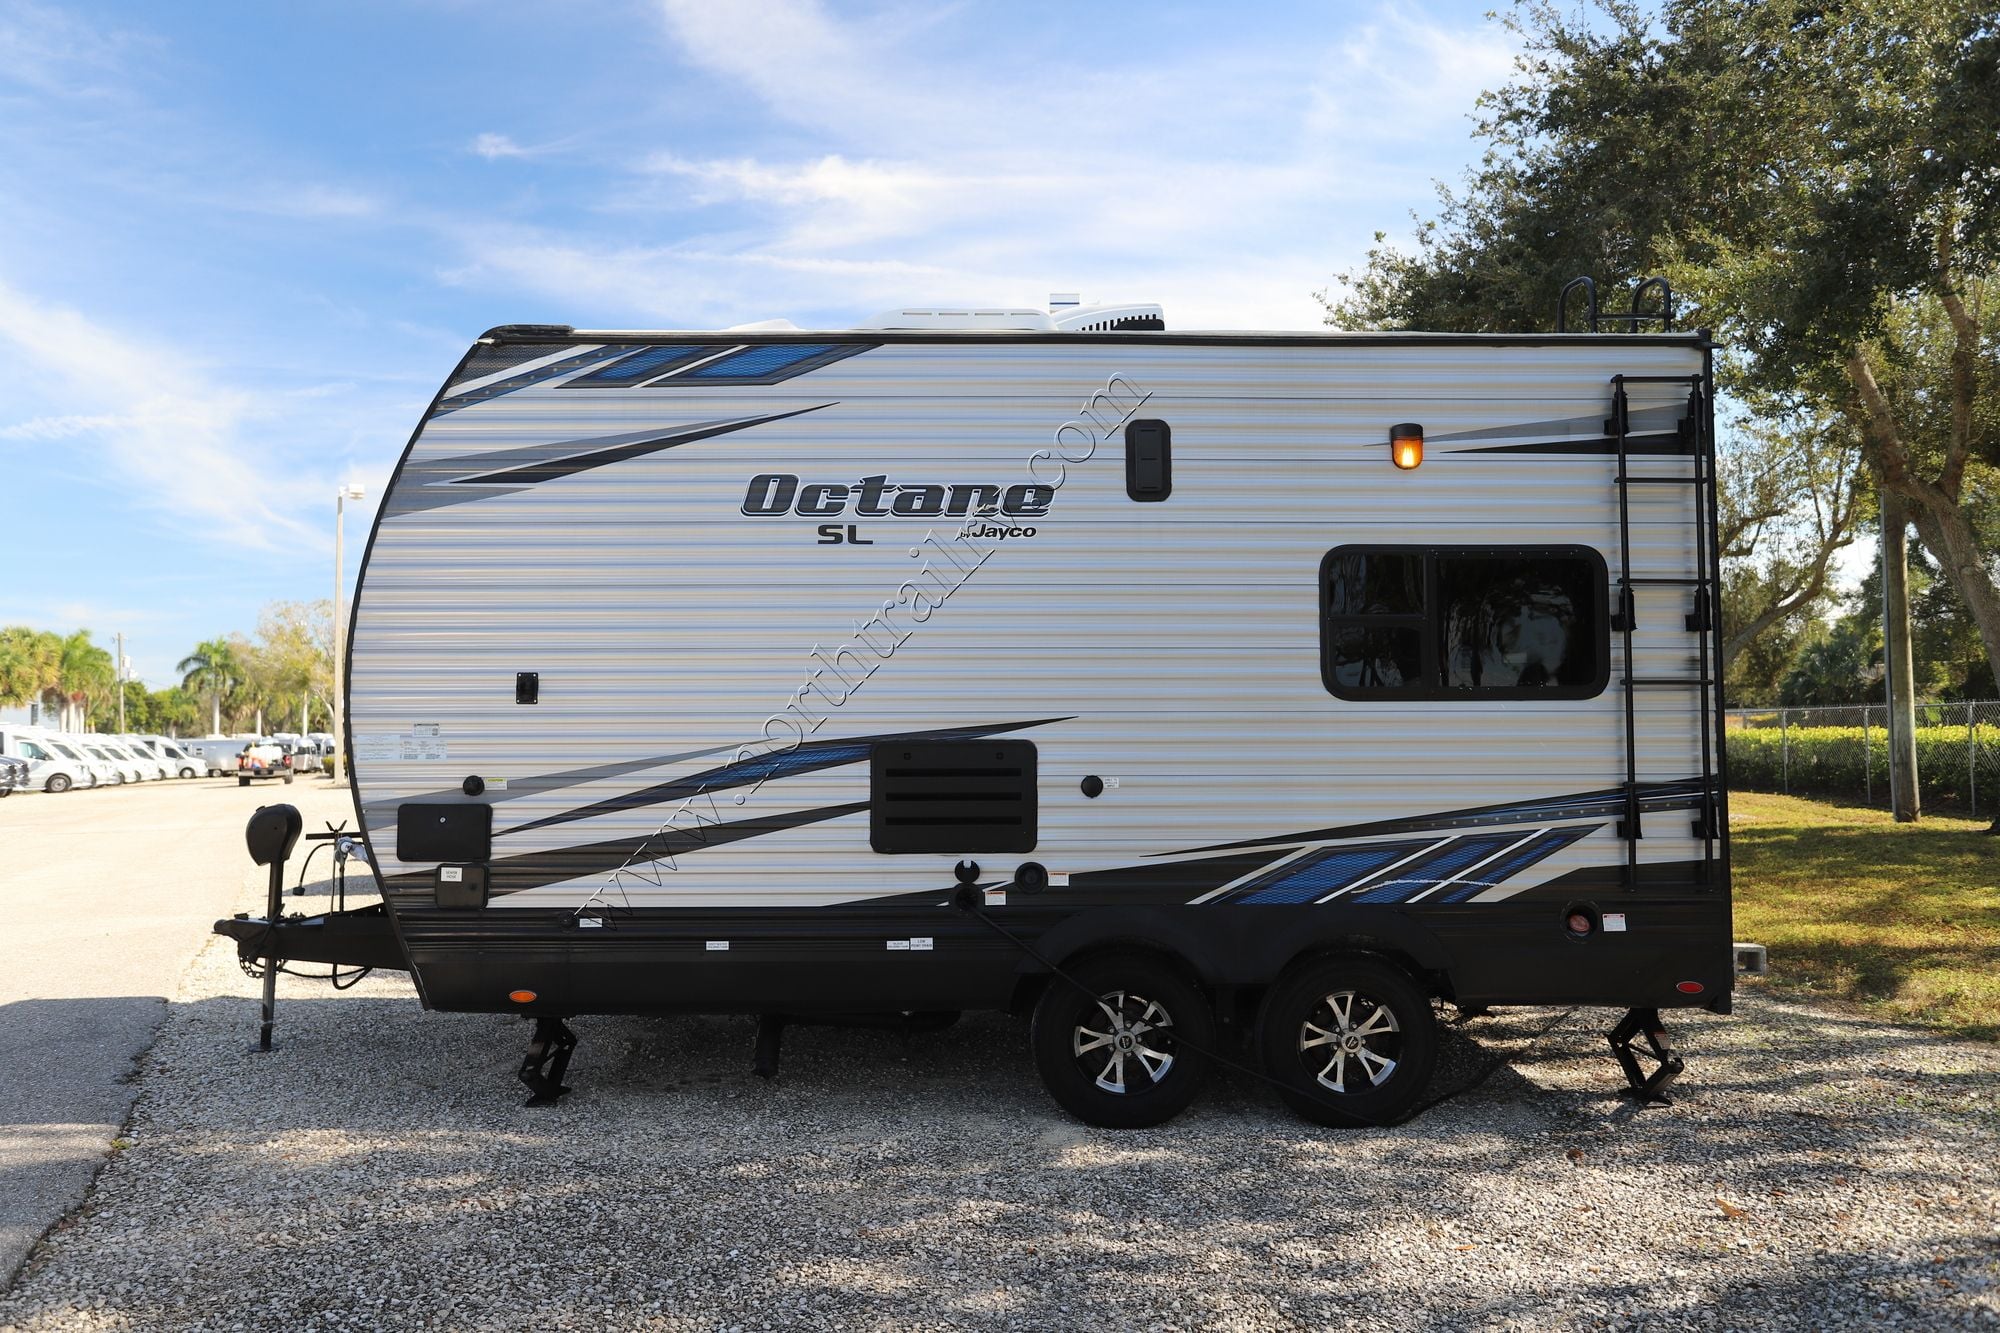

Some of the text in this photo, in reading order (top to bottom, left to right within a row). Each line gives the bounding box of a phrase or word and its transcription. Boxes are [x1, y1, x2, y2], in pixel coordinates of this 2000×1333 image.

[741, 473, 1055, 517] Octane
[817, 524, 874, 545] SL
[972, 523, 1037, 541] Jayco
